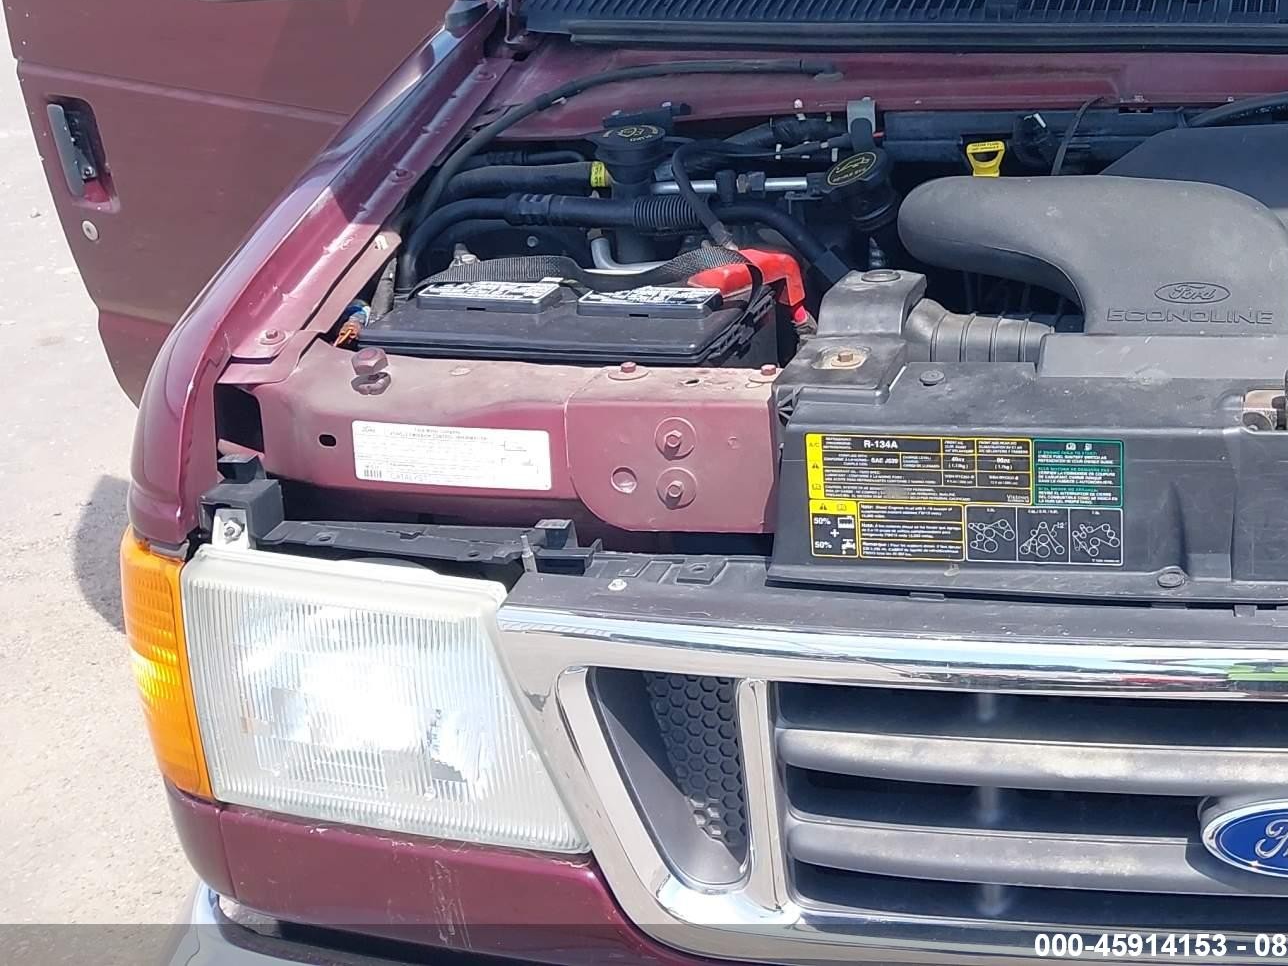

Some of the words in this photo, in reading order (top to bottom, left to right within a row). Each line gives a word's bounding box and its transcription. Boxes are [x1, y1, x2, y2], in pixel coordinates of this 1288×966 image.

[1168, 284, 1218, 300] Ford
[1106, 307, 1273, 325] ECONOLINE
[863, 439, 898, 449] R-134A
[813, 517, 832, 525] 50%
[814, 541, 833, 549] 50%
